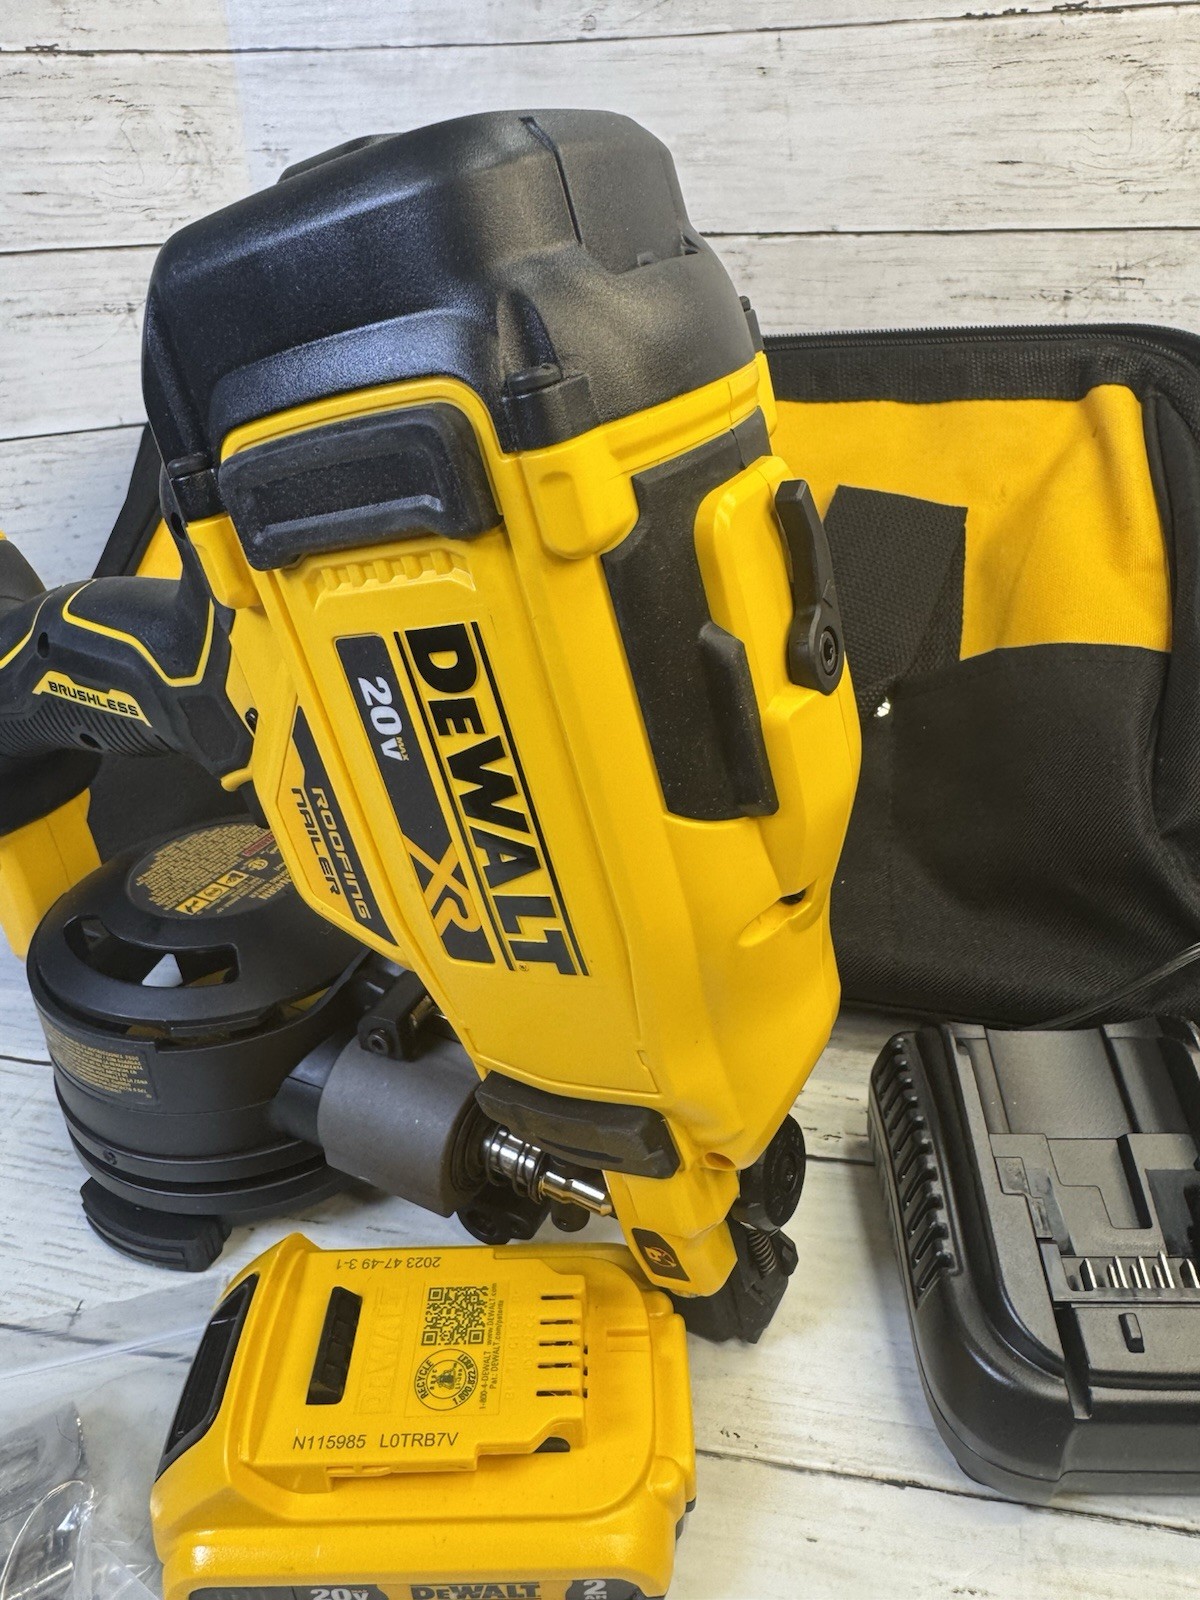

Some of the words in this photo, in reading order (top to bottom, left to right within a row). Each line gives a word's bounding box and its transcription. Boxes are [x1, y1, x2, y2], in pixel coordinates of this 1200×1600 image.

[48, 681, 140, 717] BRUSHLESS
[358, 677, 403, 761] 20V
[395, 737, 410, 761] MAX
[404, 623, 577, 975] DEWALT
[291, 788, 341, 896] NAILER
[311, 788, 372, 920] ROOFING
[403, 833, 482, 936] XR
[336, 1258, 358, 1270] 3-1
[361, 1257, 402, 1270] 47-49
[406, 1256, 442, 1269] 2023
[415, 1359, 434, 1400] RECYCLE
[292, 1434, 367, 1450] N115985
[411, 1584, 540, 1600] DEWALT
[583, 1579, 607, 1595] 2
